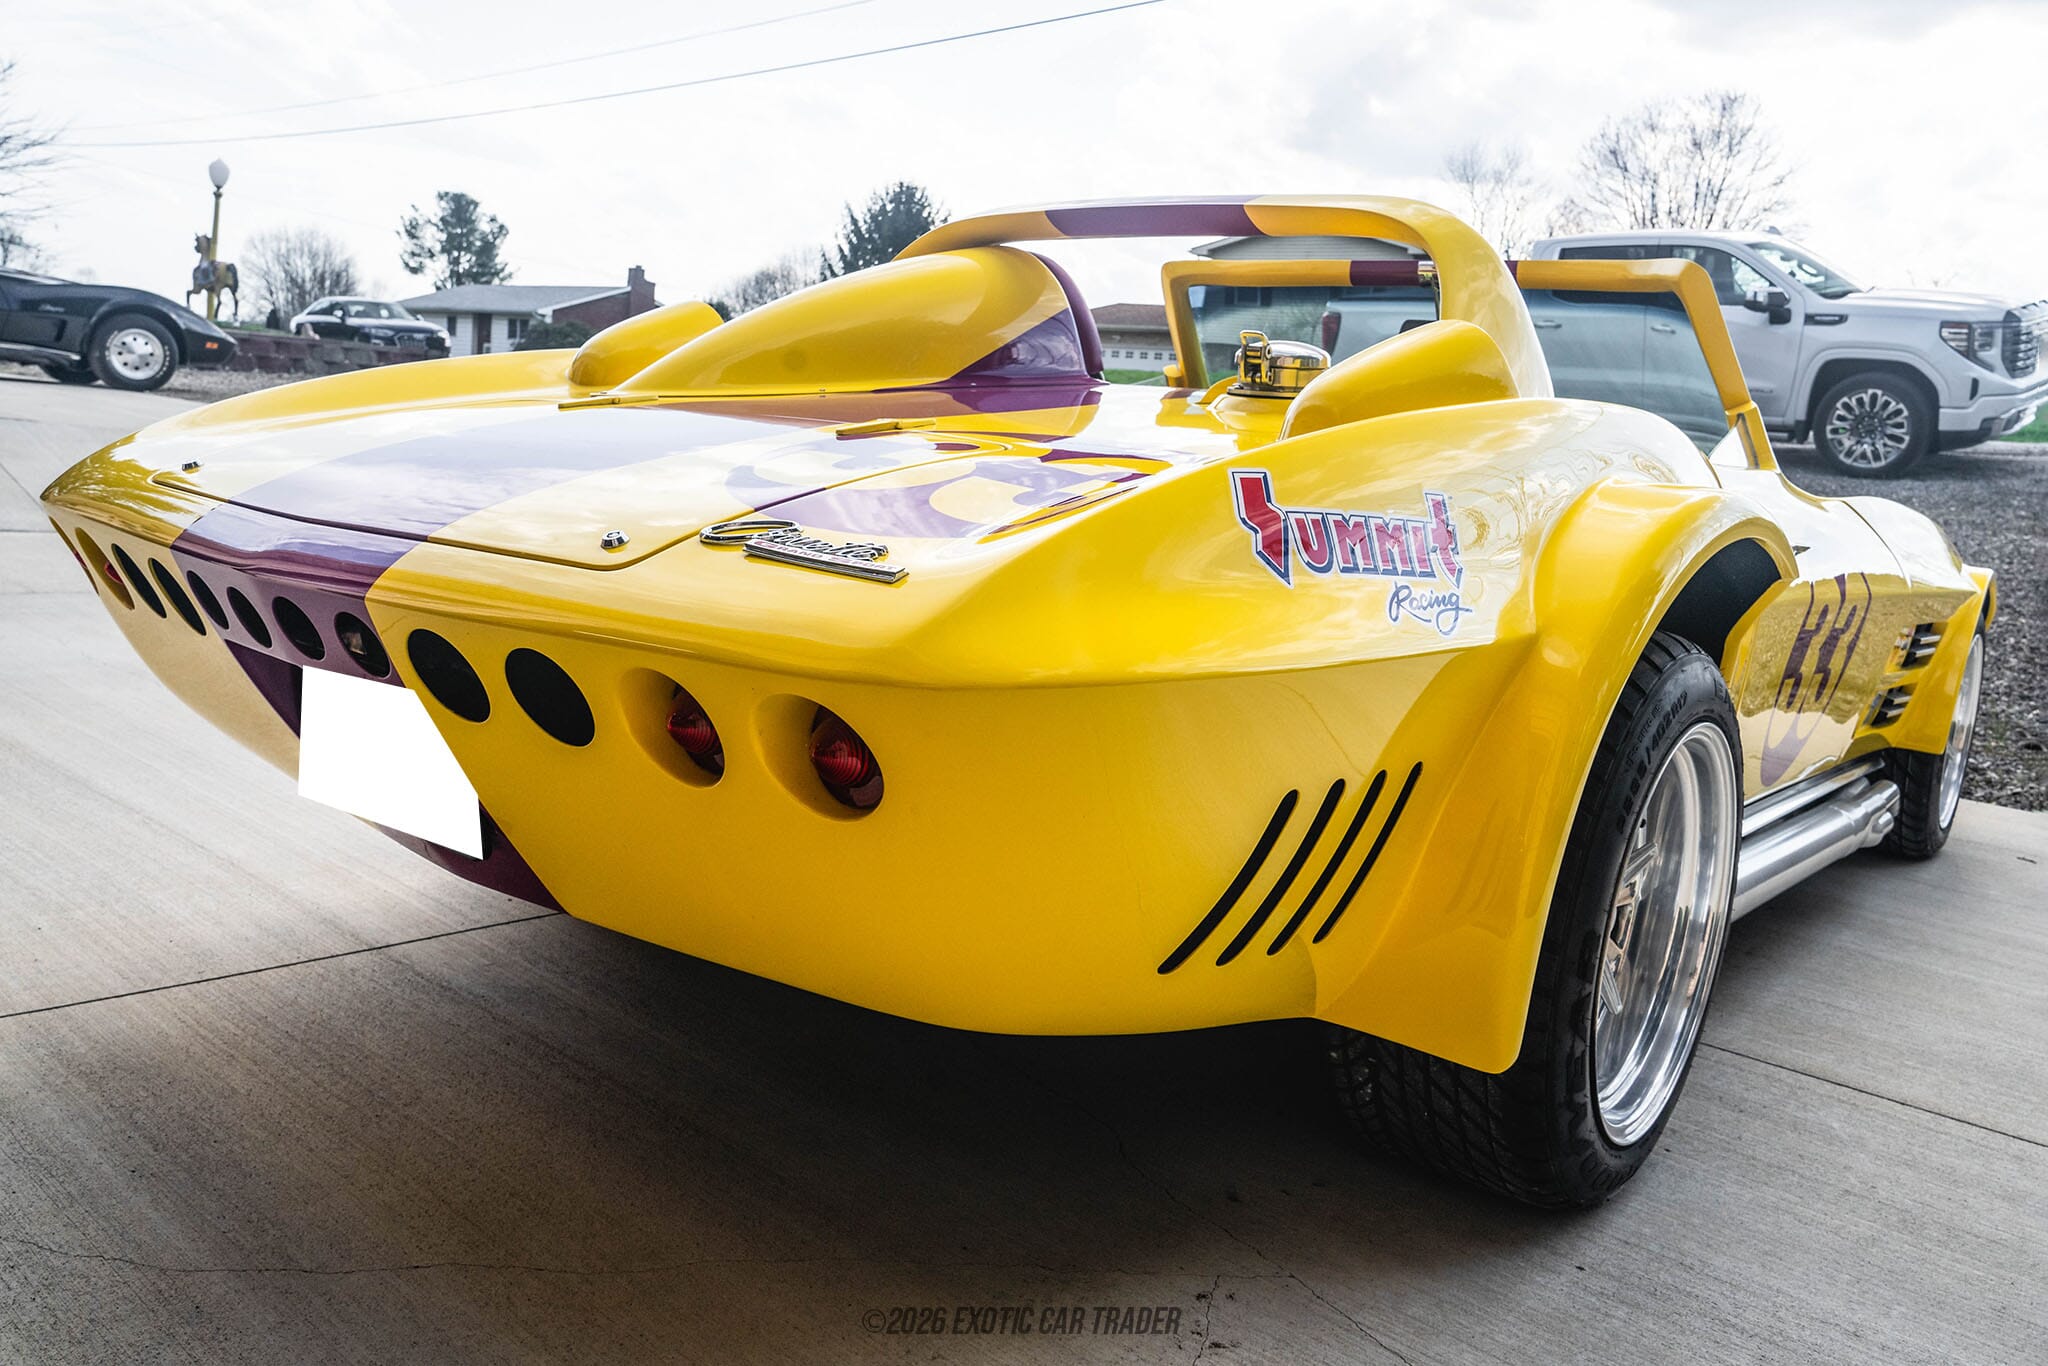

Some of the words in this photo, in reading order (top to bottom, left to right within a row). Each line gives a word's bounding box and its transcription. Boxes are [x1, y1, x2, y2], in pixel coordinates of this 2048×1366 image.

[753, 540, 824, 559] GRAND
[828, 556, 897, 571] SPORT
[1388, 581, 1473, 636] Racing
